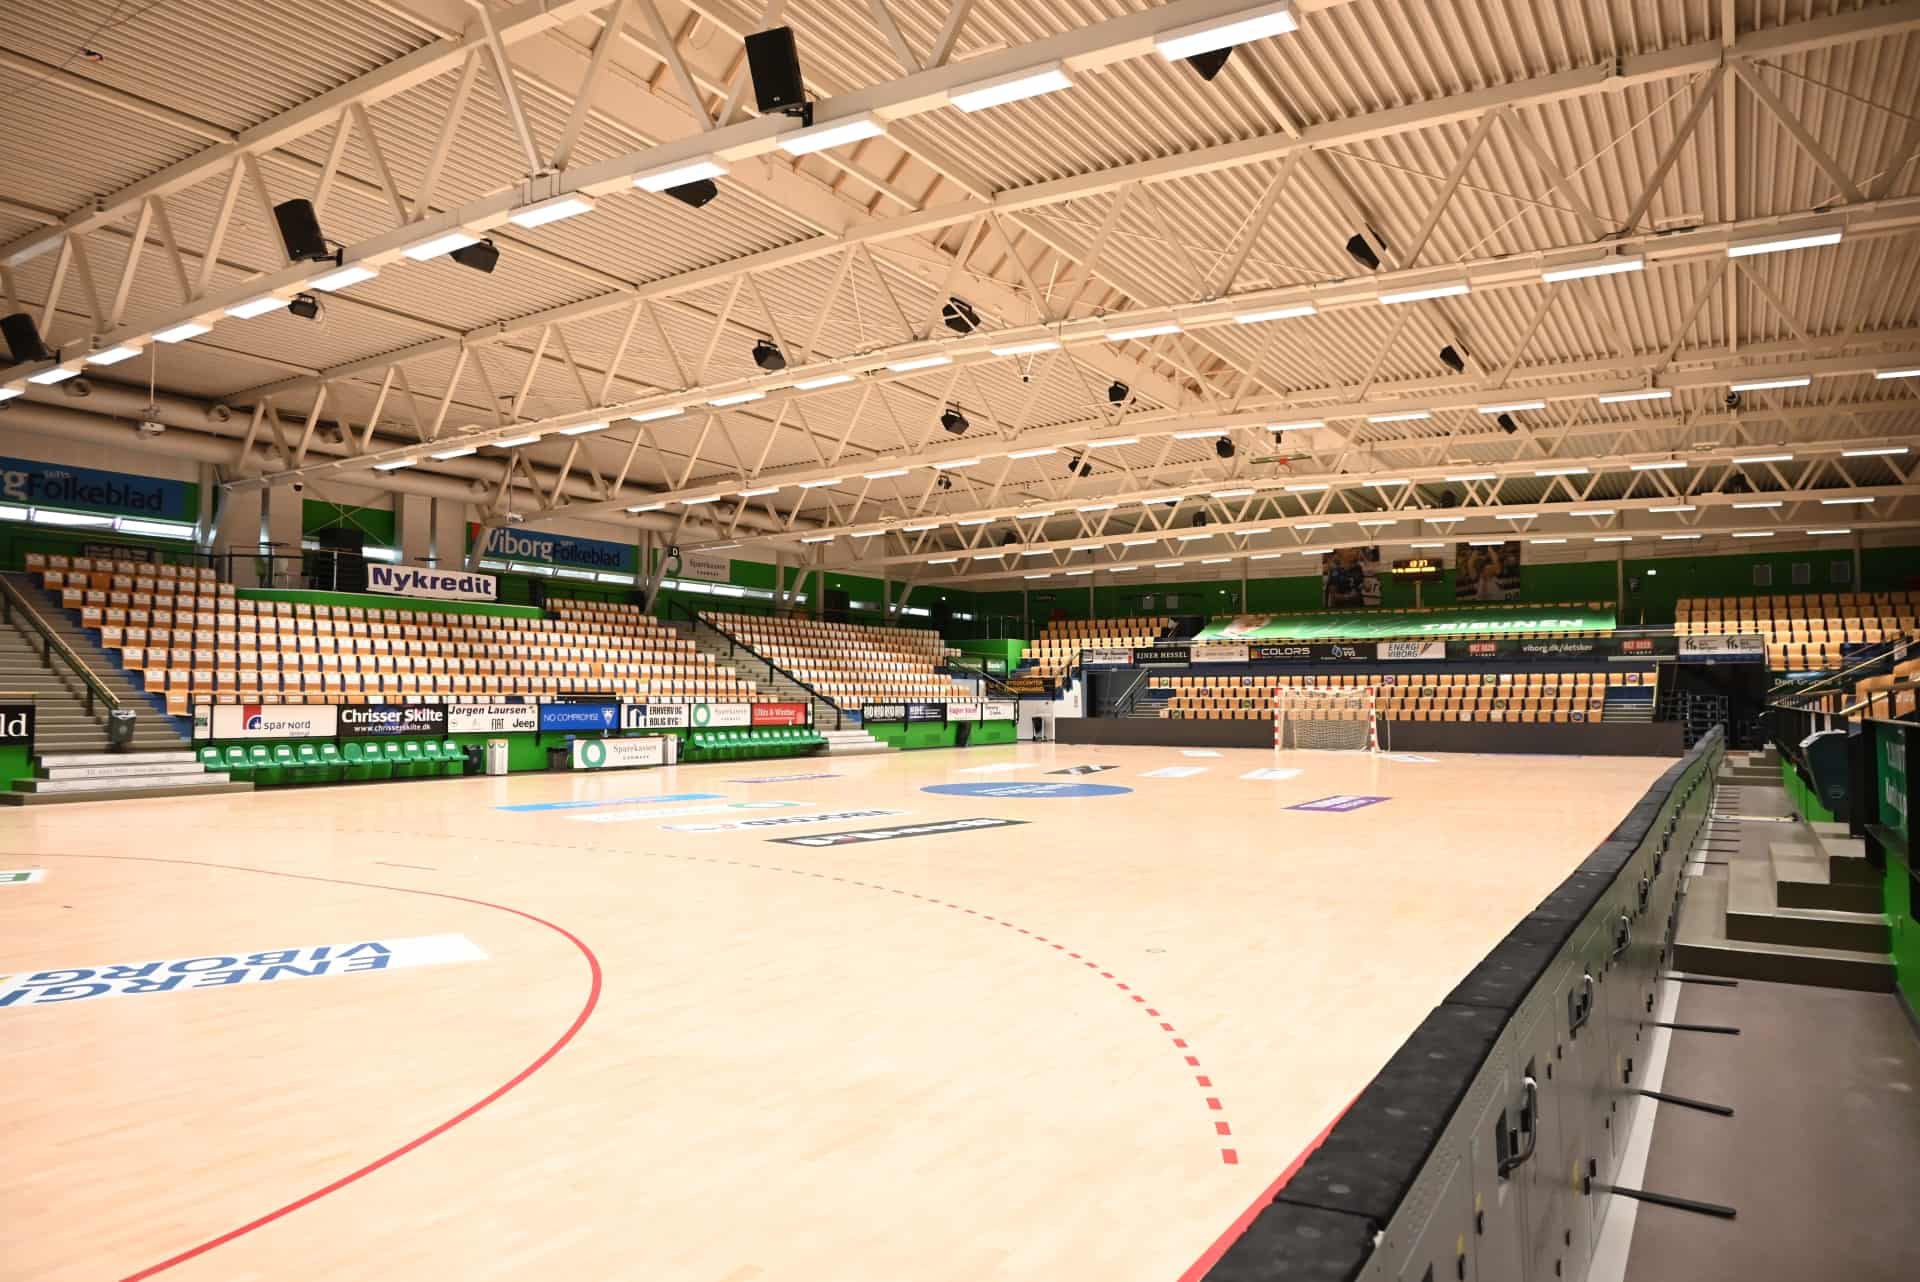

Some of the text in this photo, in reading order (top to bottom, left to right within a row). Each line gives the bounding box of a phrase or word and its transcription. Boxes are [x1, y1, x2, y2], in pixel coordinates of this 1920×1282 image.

[27, 472, 163, 511] Folkeblad
[486, 528, 620, 567] Viborg Folkeblad
[672, 547, 679, 556] D
[373, 567, 491, 595] Nykredit
[1261, 647, 1311, 656] COLORS
[342, 708, 443, 723] Chrisser Skilte
[448, 705, 527, 717] Jørgen Laursen
[544, 712, 556, 722] NO
[264, 720, 286, 731] spar
[491, 718, 535, 730] FIAT Jeep
[26, 942, 393, 987] VIBORG
[0, 955, 391, 1006] ENERGI
